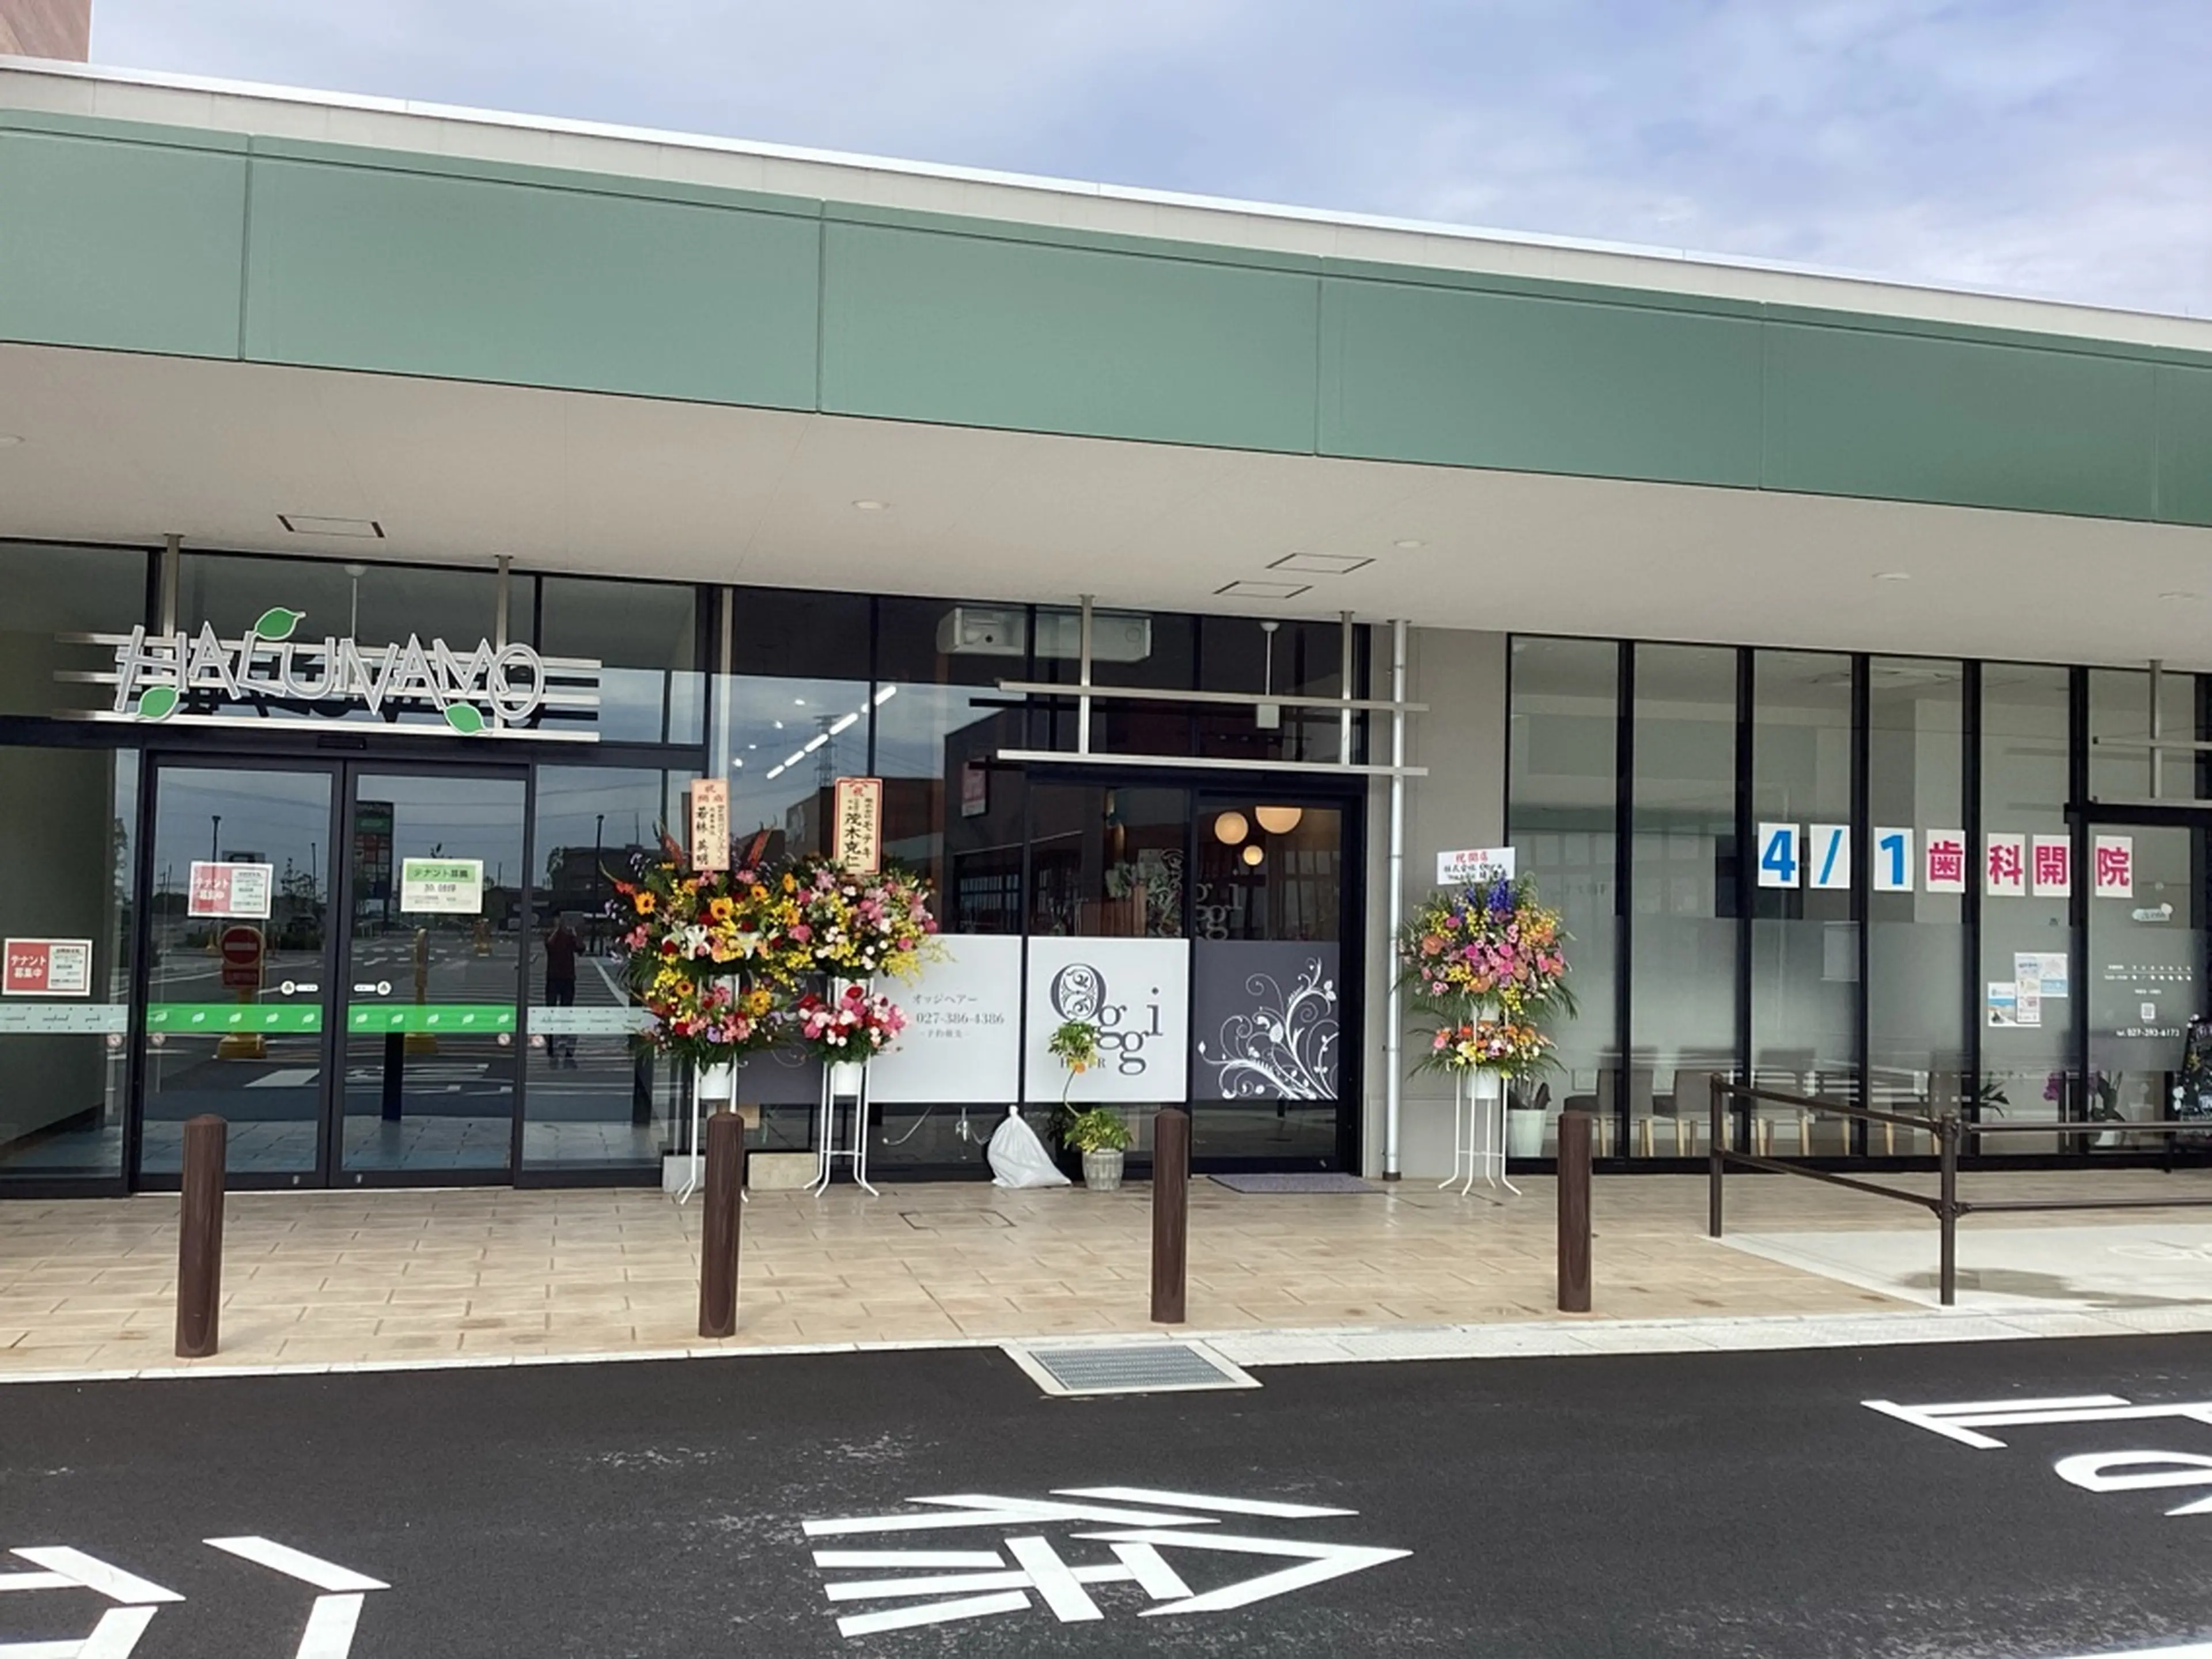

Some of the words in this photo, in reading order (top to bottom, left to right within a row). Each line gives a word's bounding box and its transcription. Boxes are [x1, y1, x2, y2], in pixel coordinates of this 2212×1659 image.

[114, 620, 545, 721] HALUNAMO
[1928, 839, 2130, 887] 歯科開院
[10, 954, 47, 967] テナント
[14, 967, 43, 979] 募集中
[916, 1012, 1005, 1025] 027-386-4386
[1050, 963, 1164, 1076] Oggi
